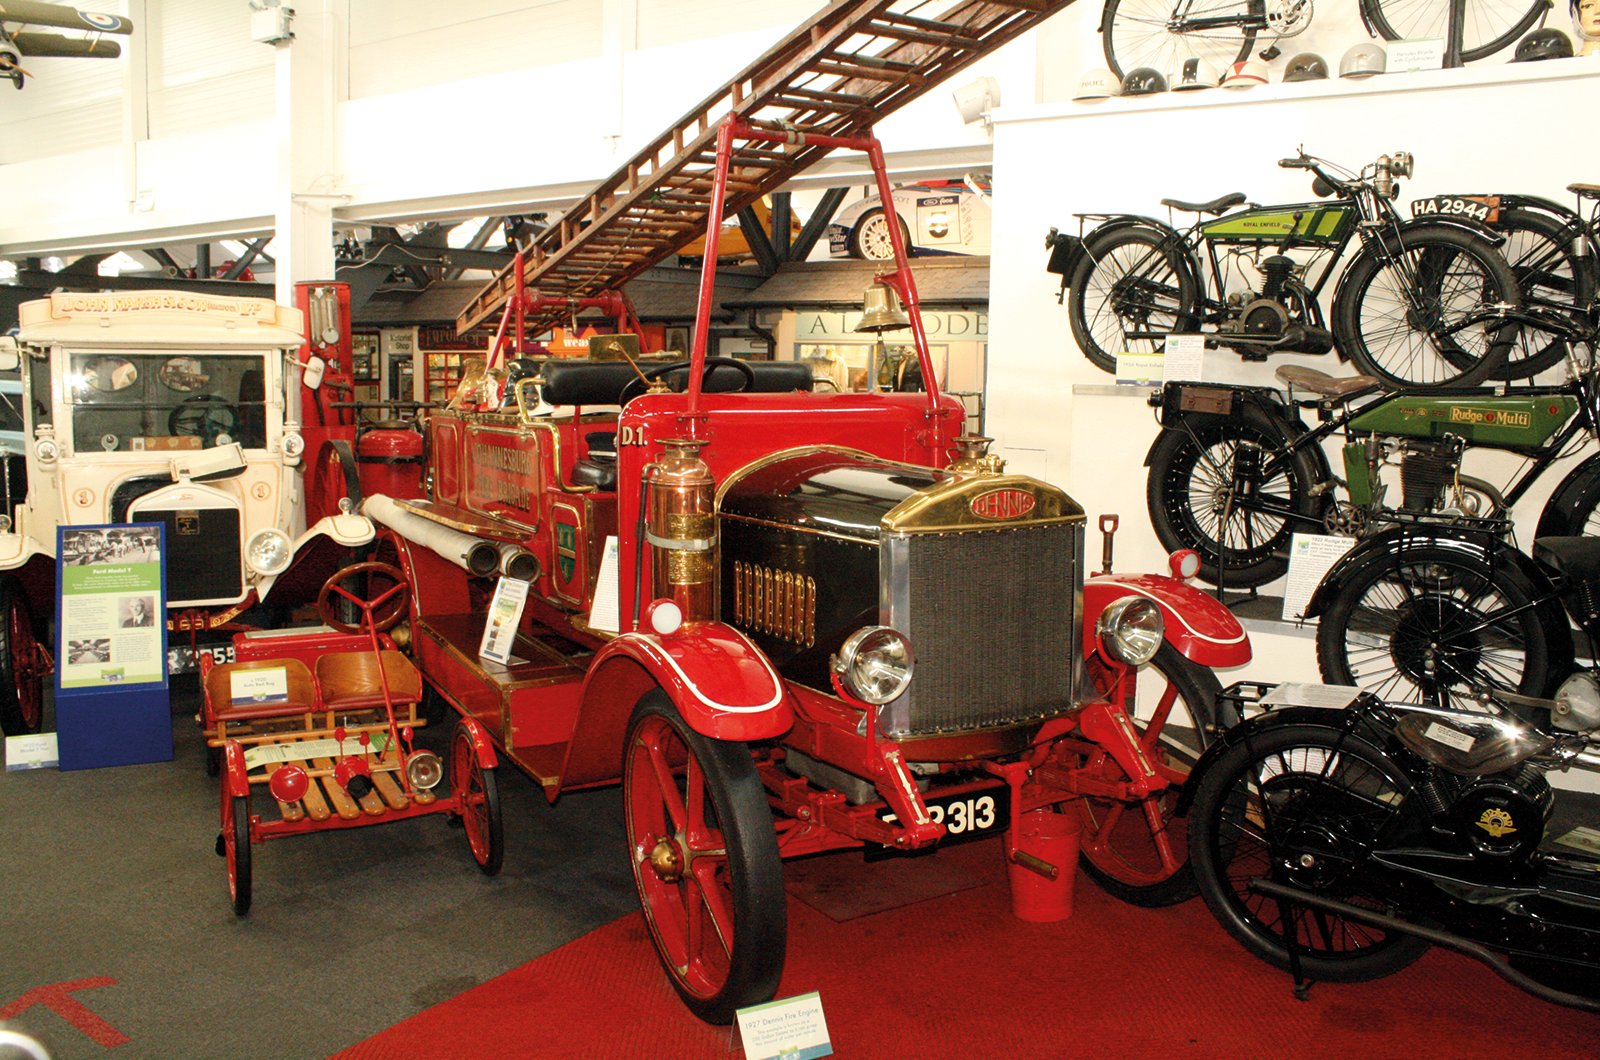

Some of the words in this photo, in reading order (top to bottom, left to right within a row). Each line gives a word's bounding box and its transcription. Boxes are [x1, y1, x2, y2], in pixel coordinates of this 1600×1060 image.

[1081, 80, 1104, 88] POLICE
[1413, 201, 1437, 215] HA
[1441, 199, 1490, 221] 2944
[62, 298, 109, 312] JOHN
[113, 296, 162, 312] MARSH
[164, 297, 176, 309] &
[177, 297, 208, 312] SON
[810, 314, 829, 334] A
[396, 342, 410, 351] Shop
[1452, 407, 1483, 423] Rudge
[1497, 411, 1528, 425] Multi
[79, 491, 88, 504] 1
[257, 485, 265, 498] 1
[976, 491, 1034, 517] DENNIS
[745, 1020, 761, 1030] 1927
[762, 1016, 784, 1026] Dennis
[785, 1013, 797, 1021] Fire
[798, 1008, 819, 1018] Engine
